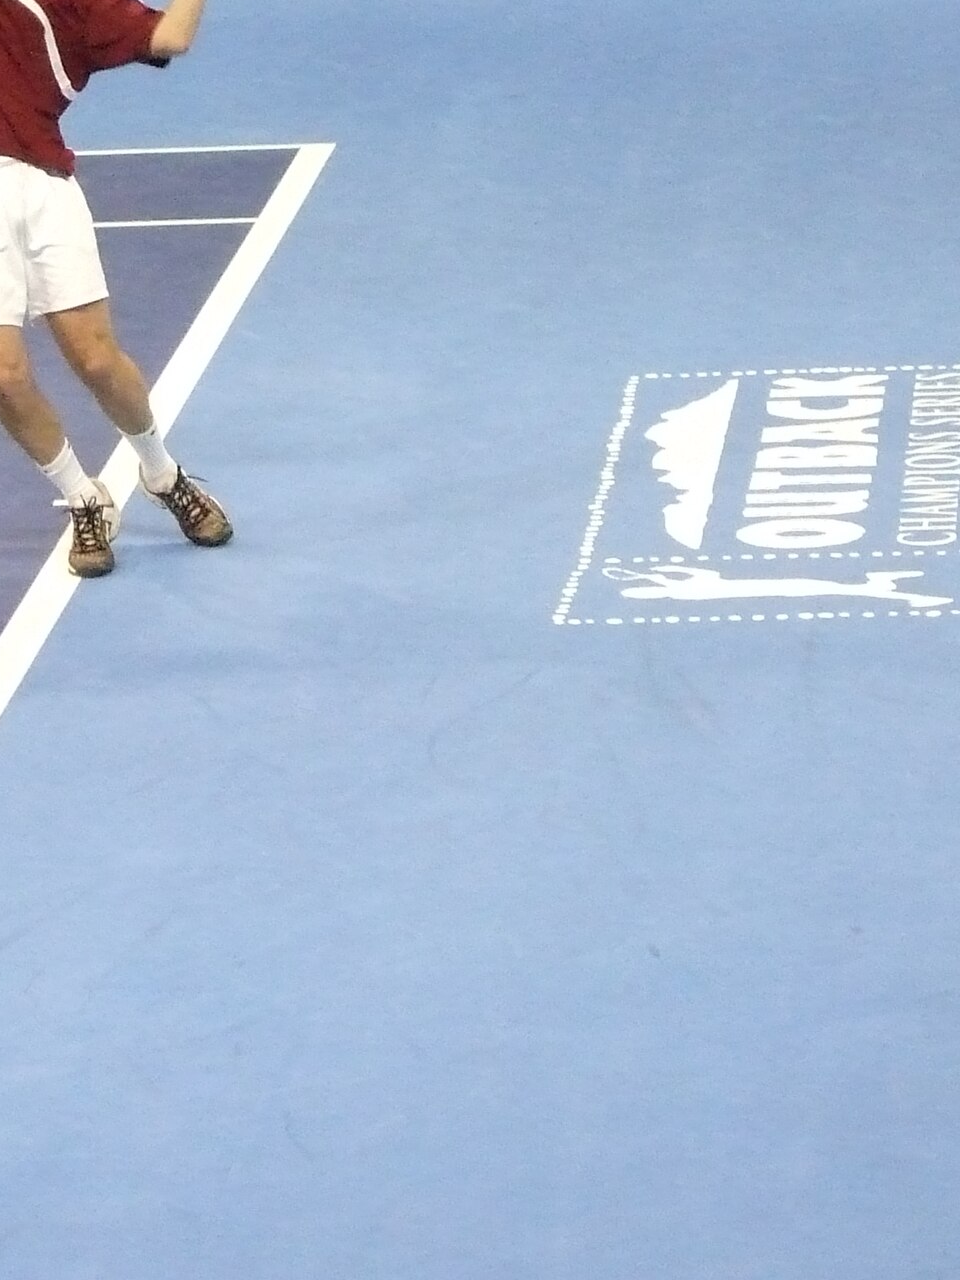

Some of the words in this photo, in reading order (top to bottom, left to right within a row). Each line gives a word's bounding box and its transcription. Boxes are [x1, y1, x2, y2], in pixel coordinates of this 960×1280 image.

[908, 372, 960, 426] SERIES
[736, 374, 889, 549] OUTBACK
[896, 431, 960, 547] CHAMPIONS
